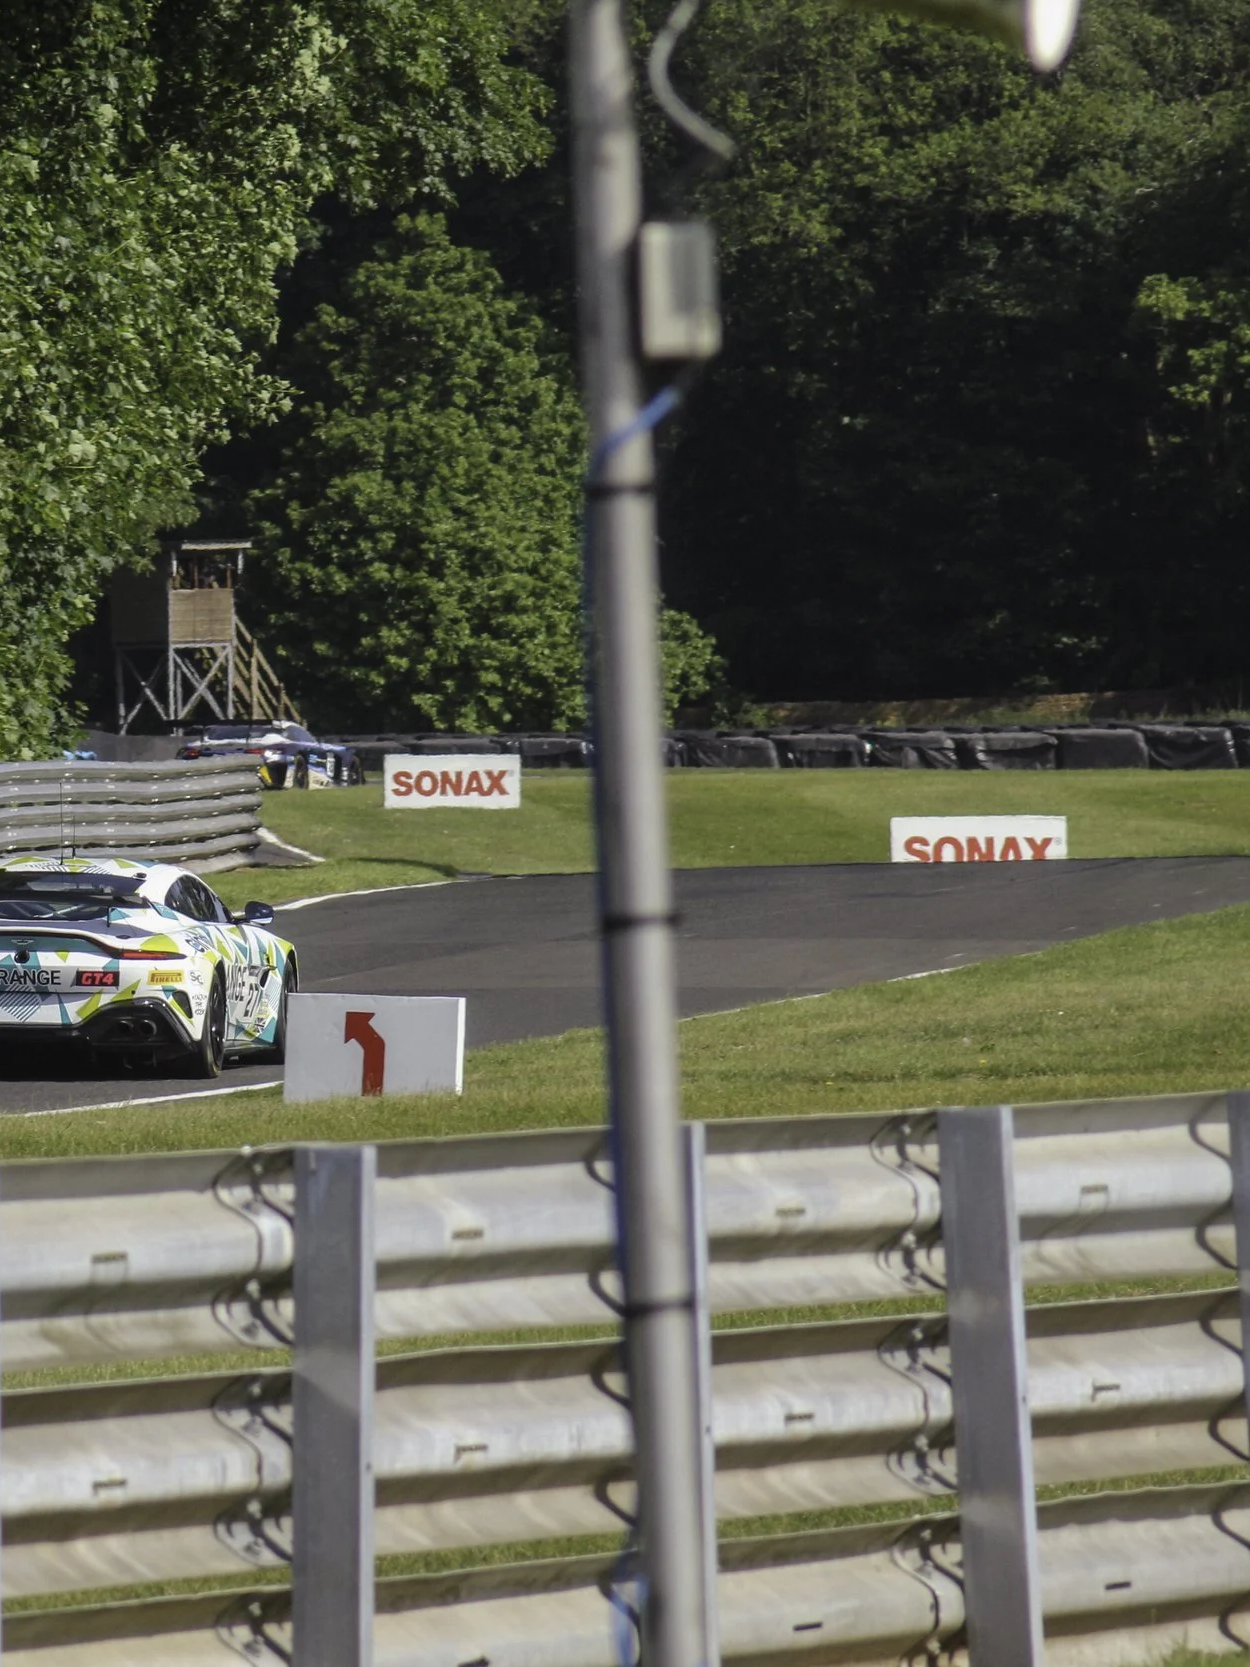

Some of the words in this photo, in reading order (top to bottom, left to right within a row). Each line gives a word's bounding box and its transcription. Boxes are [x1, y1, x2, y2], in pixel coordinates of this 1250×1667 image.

[392, 770, 510, 797] SONAX
[904, 836, 1053, 862] SONAX
[81, 972, 115, 986] GT4
